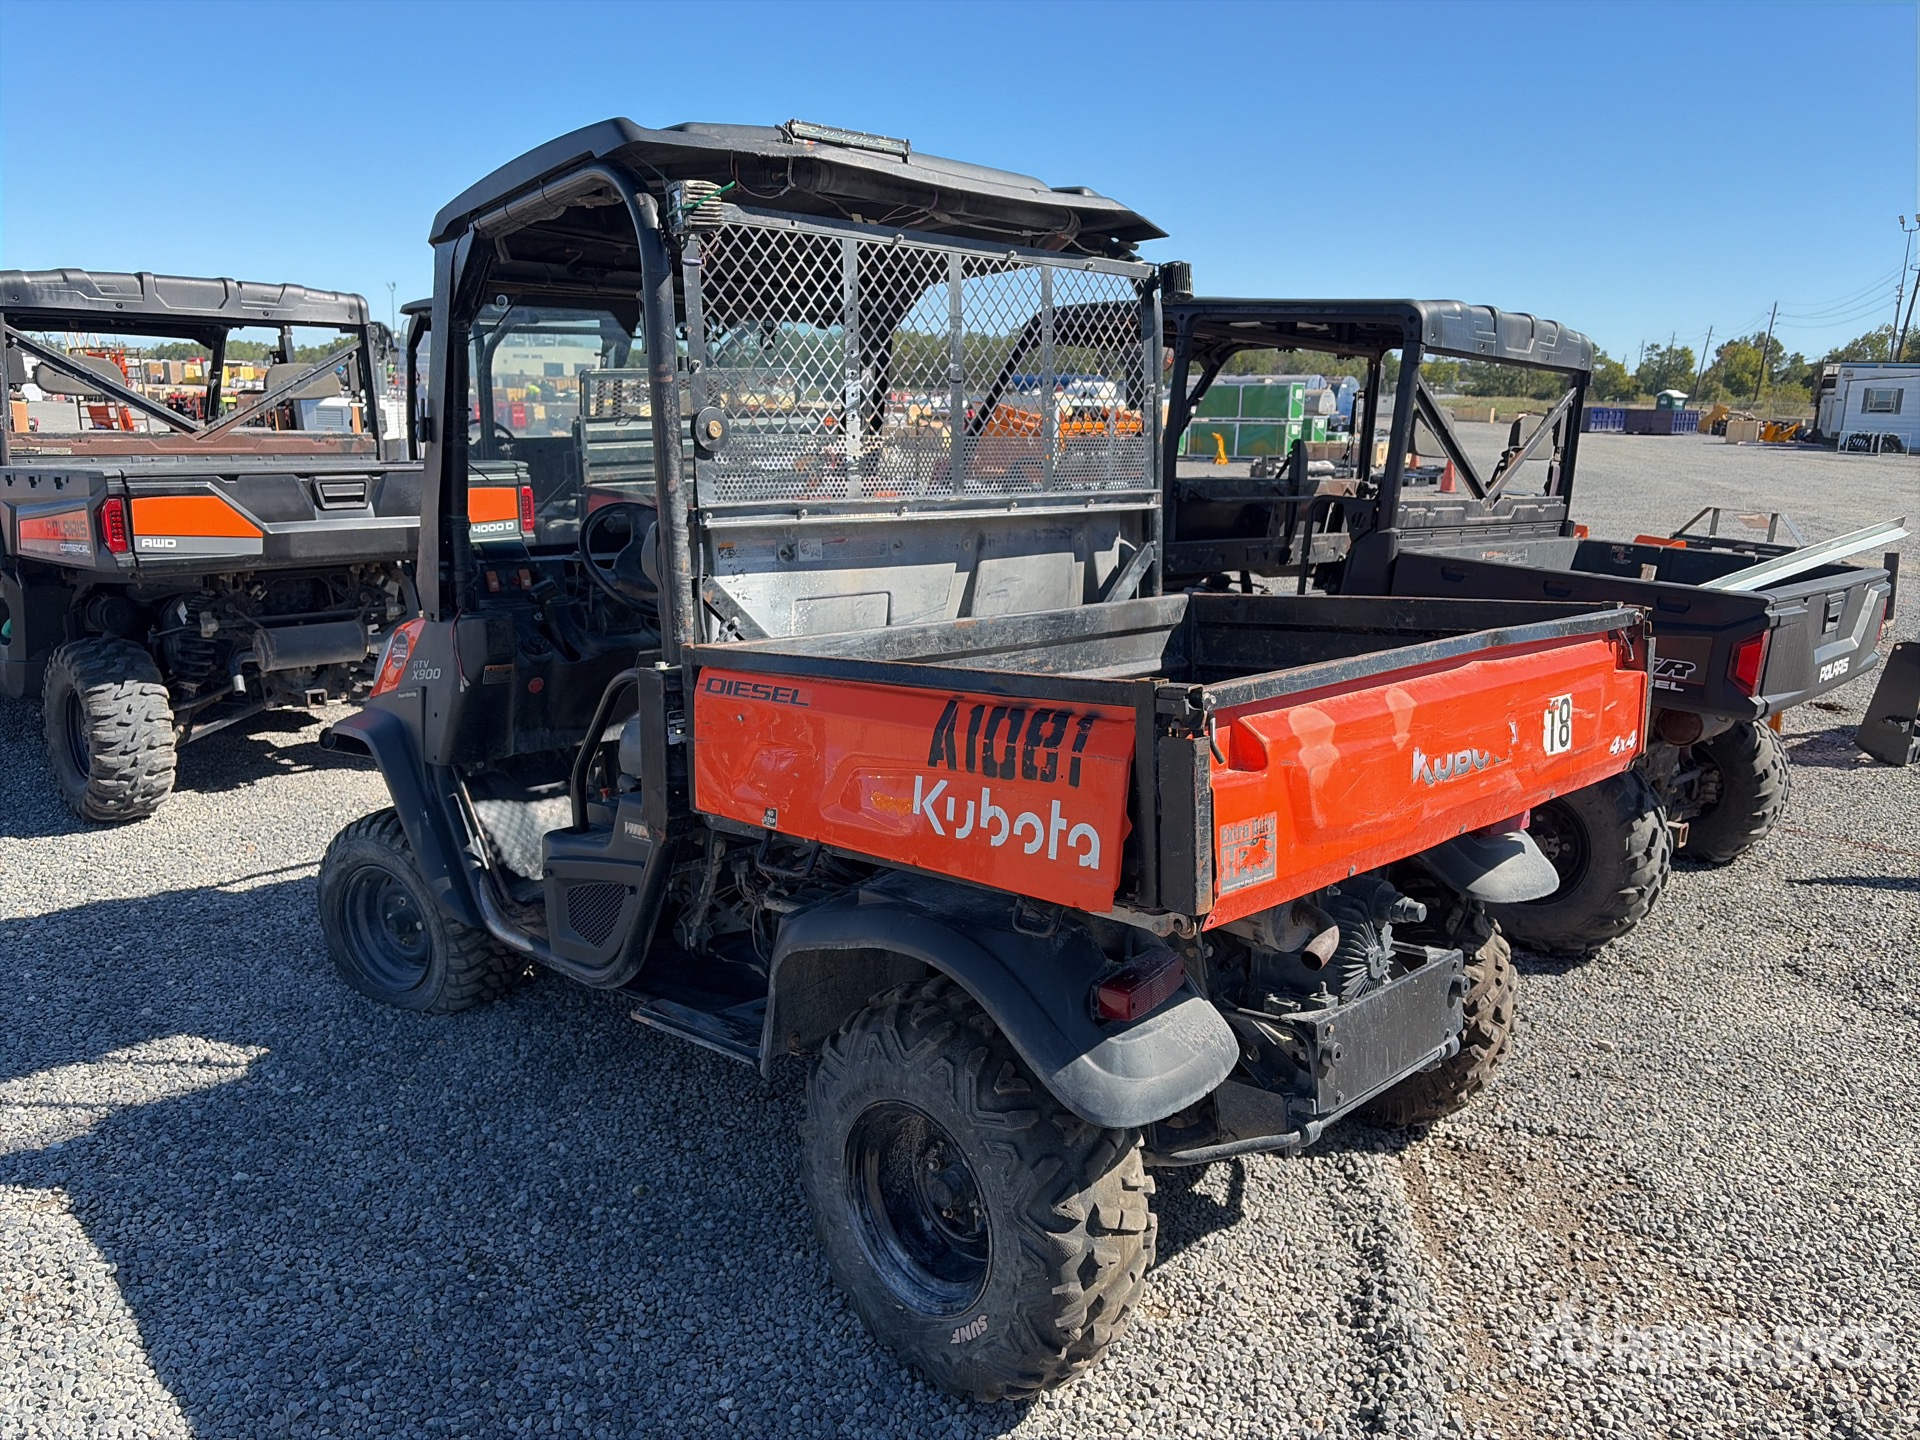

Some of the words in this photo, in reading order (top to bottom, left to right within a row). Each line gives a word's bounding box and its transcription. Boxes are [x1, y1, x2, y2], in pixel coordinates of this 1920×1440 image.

[46, 520, 88, 538] POLARIS
[472, 522, 505, 533] 4000
[505, 521, 515, 531] D
[141, 538, 177, 548] AWD
[411, 668, 442, 681] X900
[413, 659, 430, 669] RTV
[1819, 656, 1850, 684] POLARIS
[705, 677, 810, 707] DIESEL
[1609, 730, 1638, 755] 4x4
[912, 775, 1101, 870] Kubota
[1221, 824, 1250, 845] Extra
[1251, 815, 1276, 837] Duty
[949, 1314, 989, 1345] SUNF
